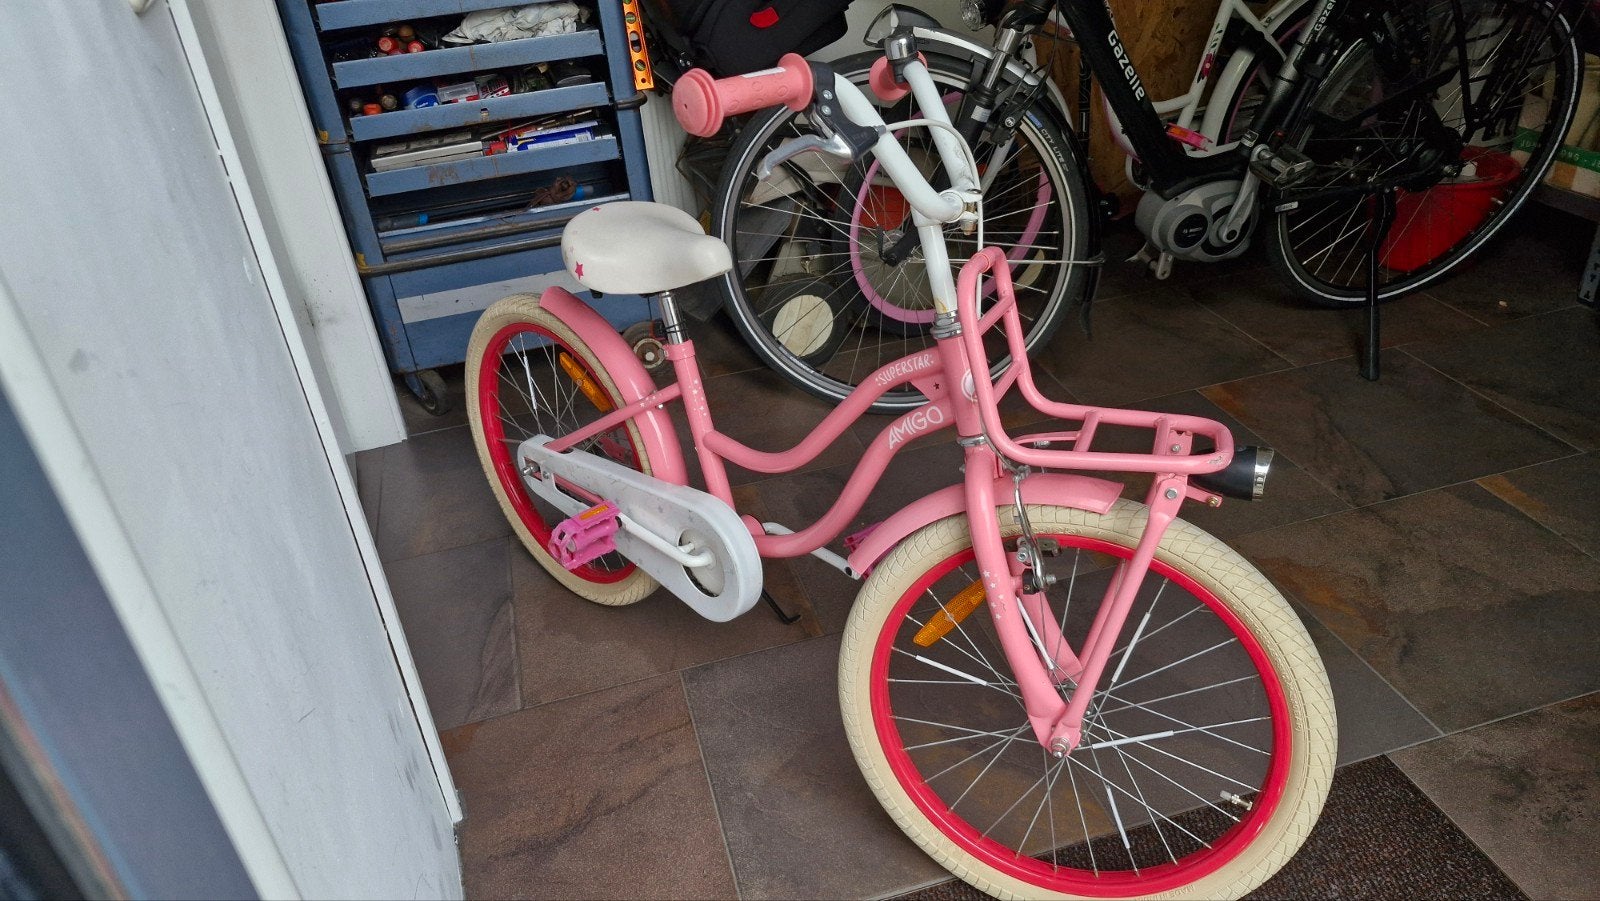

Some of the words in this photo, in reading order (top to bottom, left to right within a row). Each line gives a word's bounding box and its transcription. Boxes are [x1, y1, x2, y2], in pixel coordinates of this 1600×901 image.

[1108, 30, 1145, 101] Gazelle
[1040, 128, 1055, 144] CITY
[888, 405, 944, 450] AMIGO
